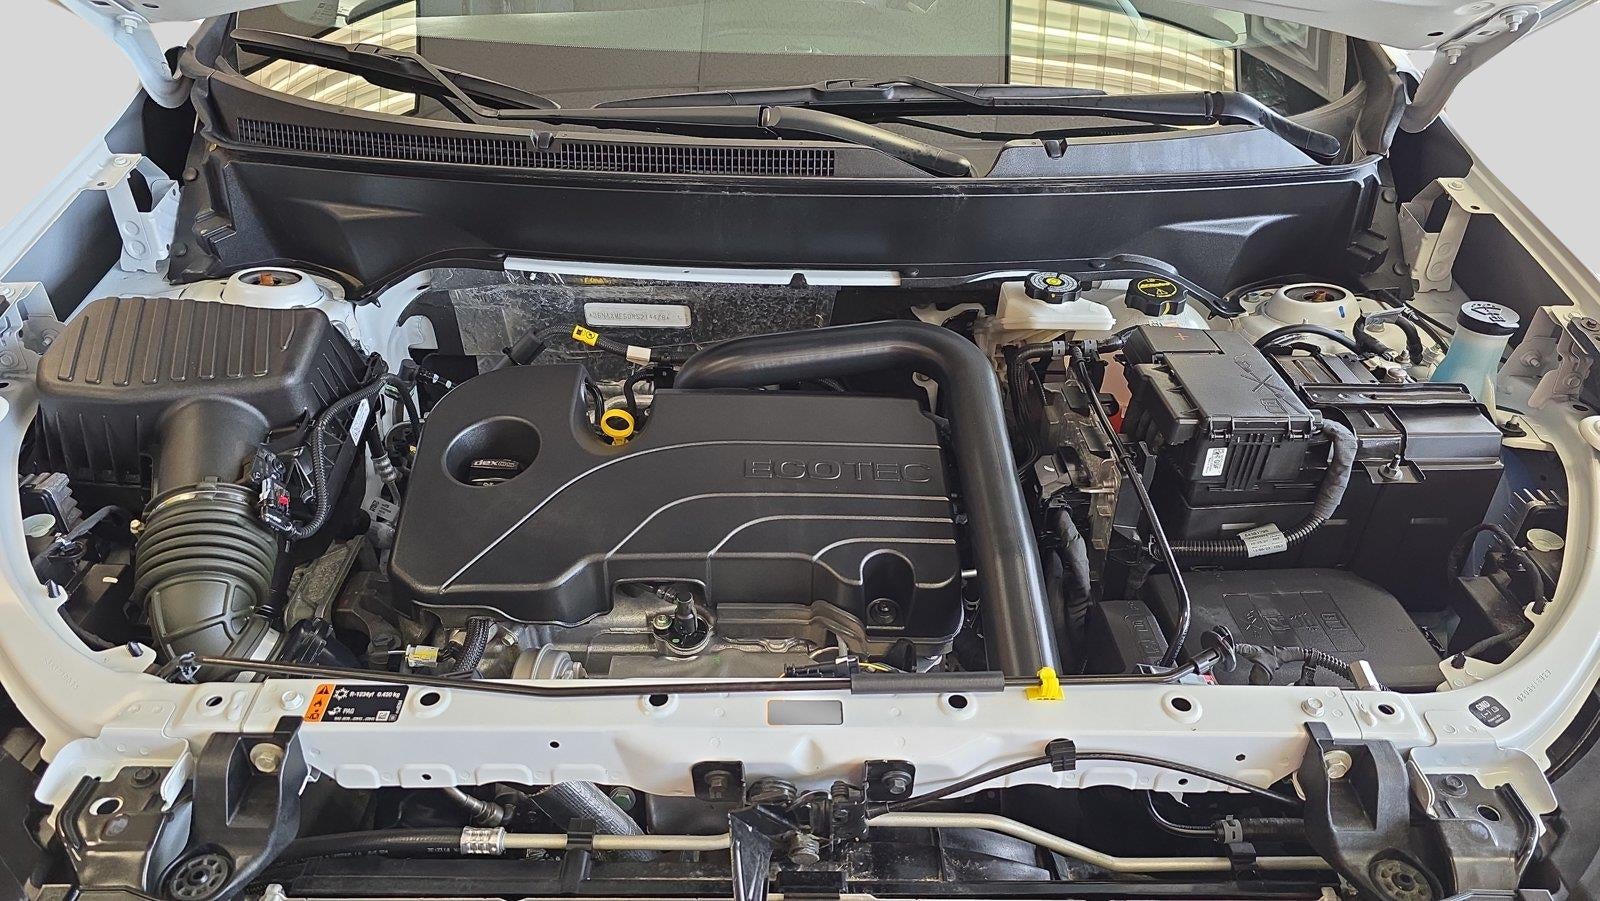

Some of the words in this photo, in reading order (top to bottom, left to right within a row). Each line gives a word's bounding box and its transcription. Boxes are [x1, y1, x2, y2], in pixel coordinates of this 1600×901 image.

[473, 459, 515, 468] dexos
[743, 460, 932, 483] ECOTEC
[349, 691, 375, 699] R-1234yf
[392, 691, 401, 699] kg
[1475, 700, 1491, 712] GND
[342, 707, 355, 715] PAG
